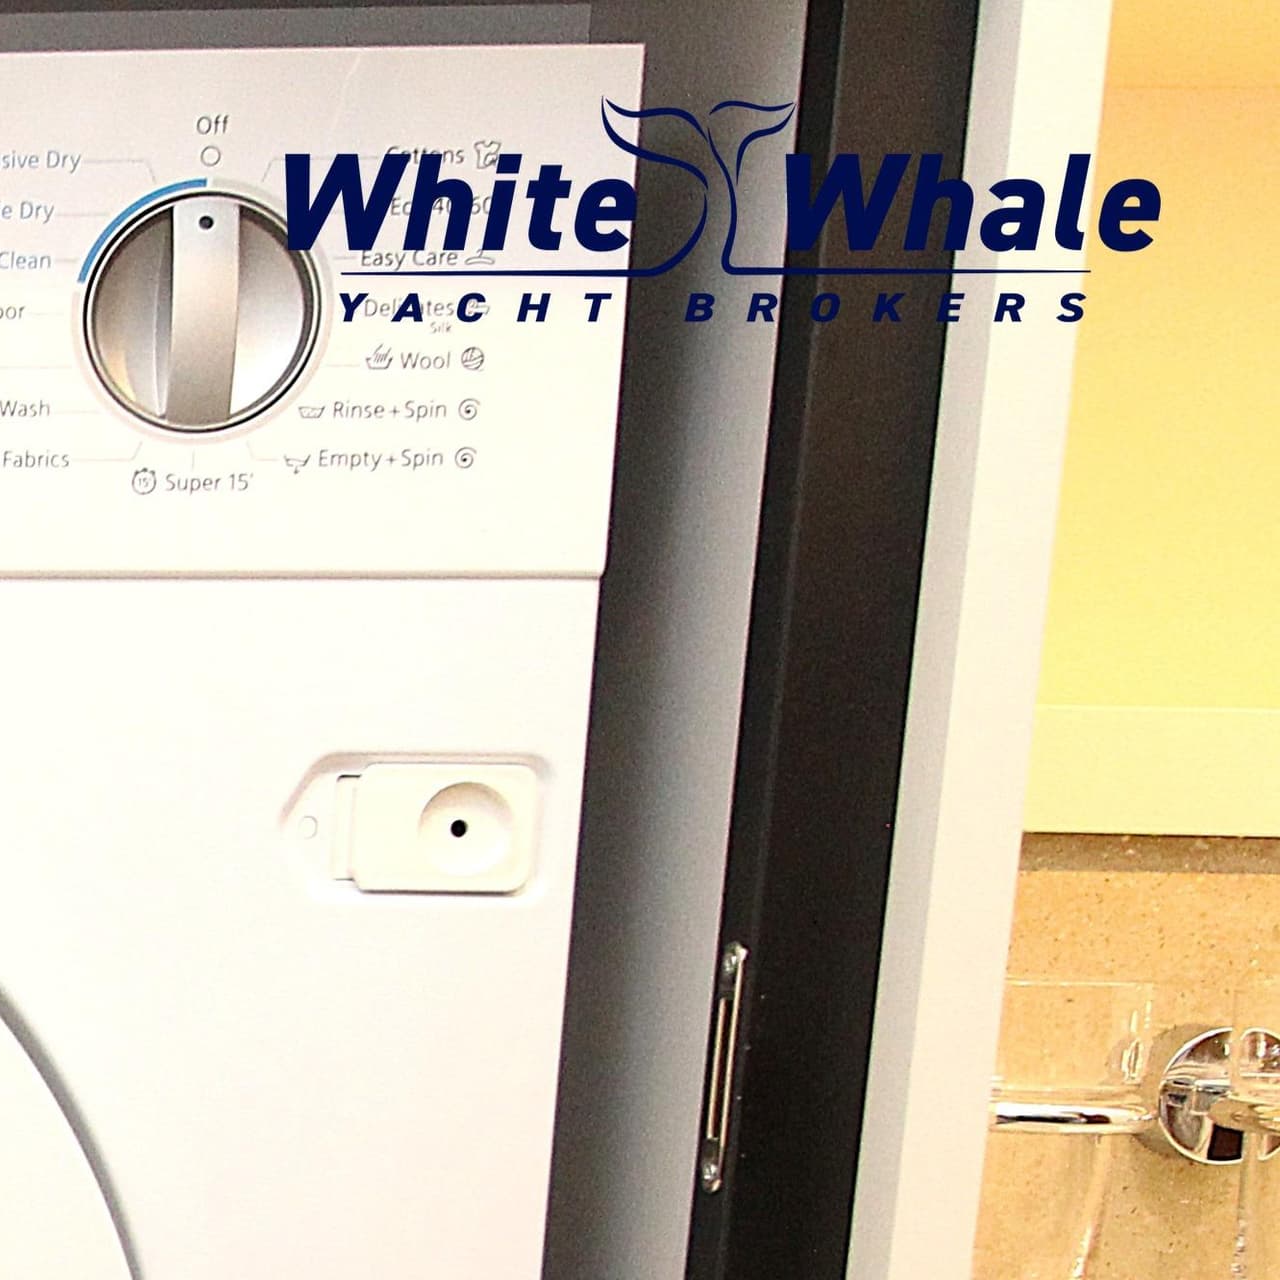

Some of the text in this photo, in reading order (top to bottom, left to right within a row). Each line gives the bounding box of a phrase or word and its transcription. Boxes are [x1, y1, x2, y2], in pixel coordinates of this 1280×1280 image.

[196, 115, 229, 135] Off
[46, 151, 81, 174] Dry
[20, 201, 55, 224] Dry
[361, 250, 458, 271] Easy Care
[400, 351, 451, 370] Wool
[0, 400, 51, 417] Wash
[333, 401, 385, 419] Rinse
[405, 401, 448, 422] Spin
[2, 451, 70, 469] Fabrics
[318, 450, 381, 472] Empty
[401, 449, 444, 470] Spin
[165, 473, 221, 496] Super
